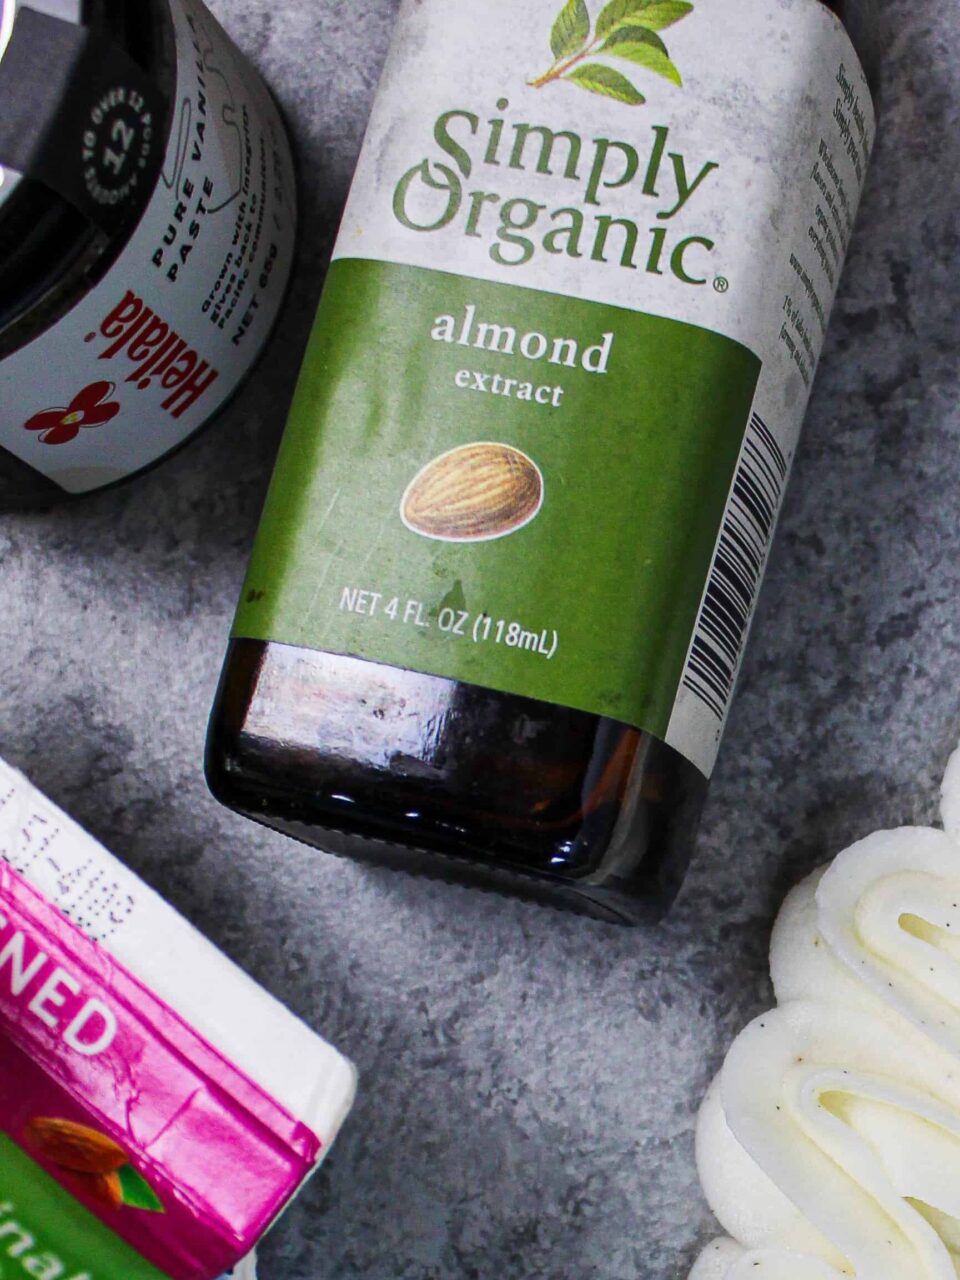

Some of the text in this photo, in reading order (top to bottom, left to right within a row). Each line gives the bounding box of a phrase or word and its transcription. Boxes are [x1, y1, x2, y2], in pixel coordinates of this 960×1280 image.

[103, 118, 134, 175] 12
[432, 98, 719, 220] Simply
[151, 178, 196, 267] PURE
[165, 175, 214, 283] PASTE
[201, 251, 233, 313] Grown
[231, 200, 246, 246] with
[98, 289, 219, 419] Heilala
[231, 295, 260, 346] NET
[430, 304, 614, 374] almond
[454, 368, 564, 408] extract
[339, 587, 558, 660] NET 4 FL. OZ (118mL)
[0, 913, 118, 1056] NED
